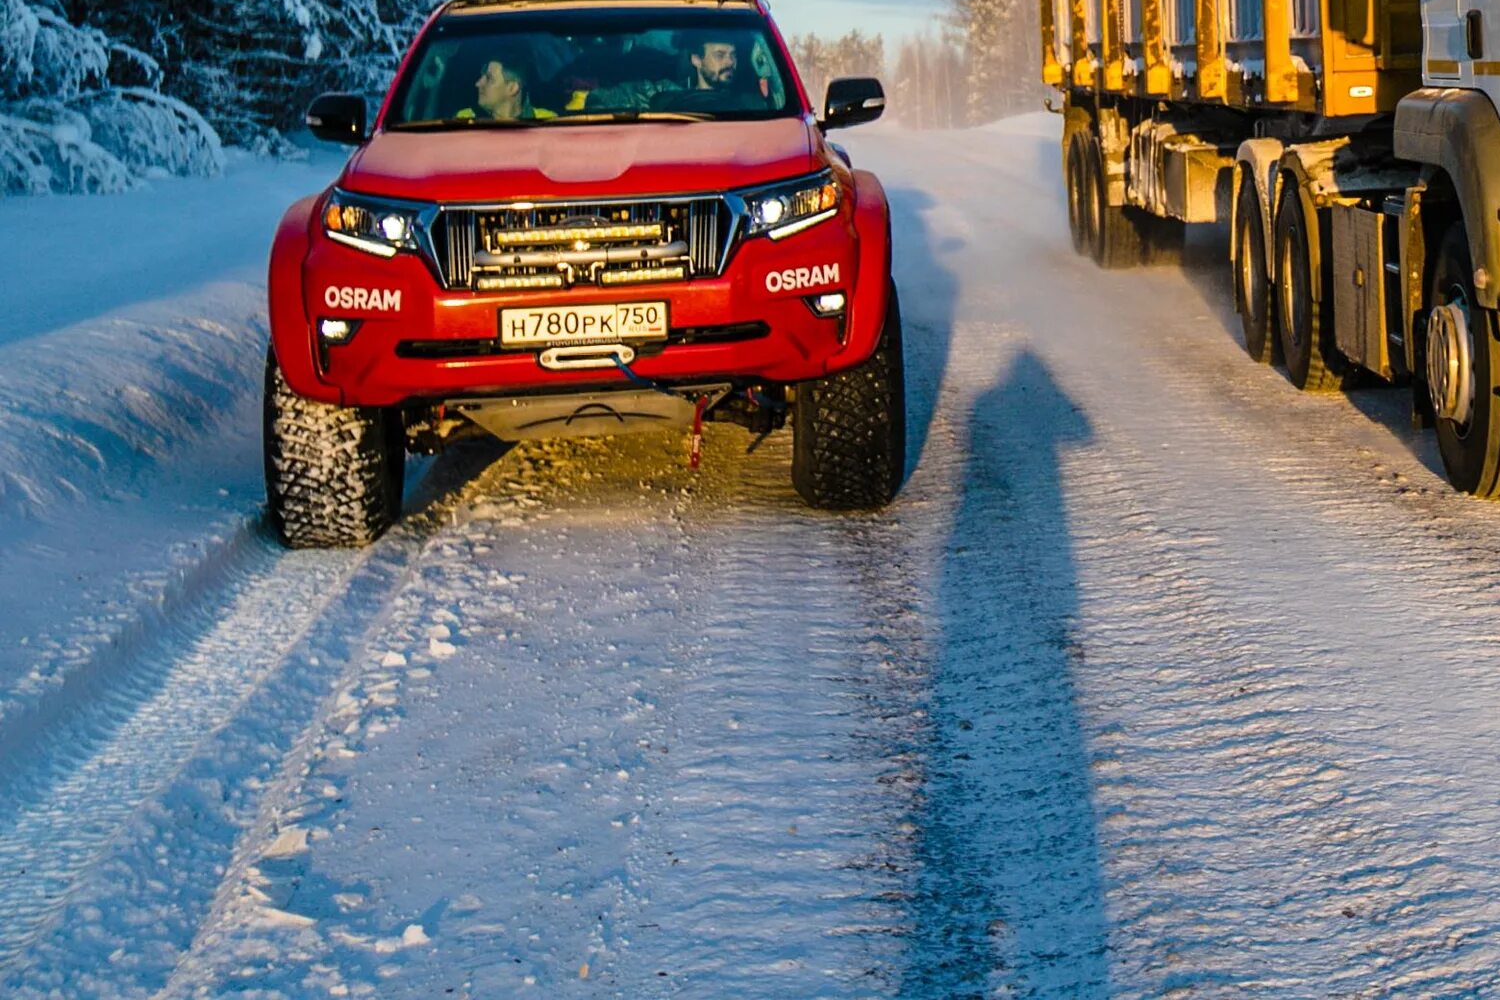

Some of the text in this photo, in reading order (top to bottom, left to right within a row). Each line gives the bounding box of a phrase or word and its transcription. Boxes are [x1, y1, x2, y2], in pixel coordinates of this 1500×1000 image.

[765, 262, 840, 293] OSRAM
[324, 285, 402, 312] OSRAM
[619, 306, 658, 326] 750
